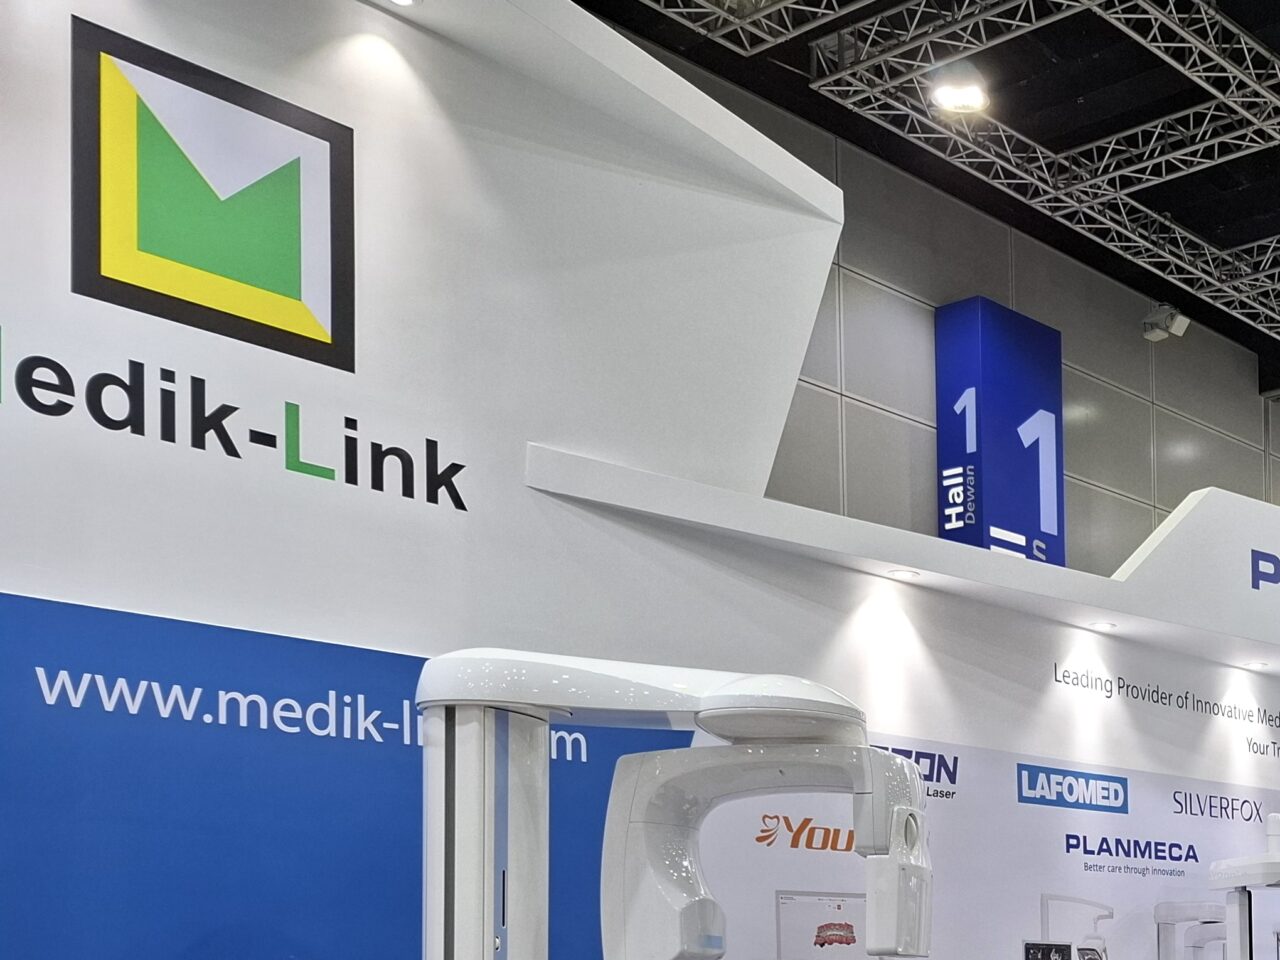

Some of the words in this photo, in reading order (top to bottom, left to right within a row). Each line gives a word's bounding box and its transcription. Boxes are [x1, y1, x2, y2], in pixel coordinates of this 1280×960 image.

[0, 326, 468, 512] edik-Link
[953, 387, 977, 454] 1
[964, 465, 976, 524] Dewan
[1017, 408, 1058, 536] 1
[942, 466, 964, 530] Hall
[35, 666, 588, 763] www.medik-lim
[1053, 662, 1113, 699] Leading
[1117, 677, 1173, 708] Provider
[1176, 691, 1189, 710] of
[1192, 694, 1254, 723] Innovative
[1246, 737, 1270, 755] Your
[926, 786, 957, 799] Laser
[1019, 768, 1125, 808] LAFOMED
[1172, 791, 1263, 824] SILVERFOX
[782, 817, 855, 852] YOU
[1065, 834, 1199, 863] PLANMECA
[1083, 862, 1106, 873] Better
[1107, 865, 1122, 873] care
[1123, 864, 1150, 877] through
[1151, 866, 1185, 877] innovation
